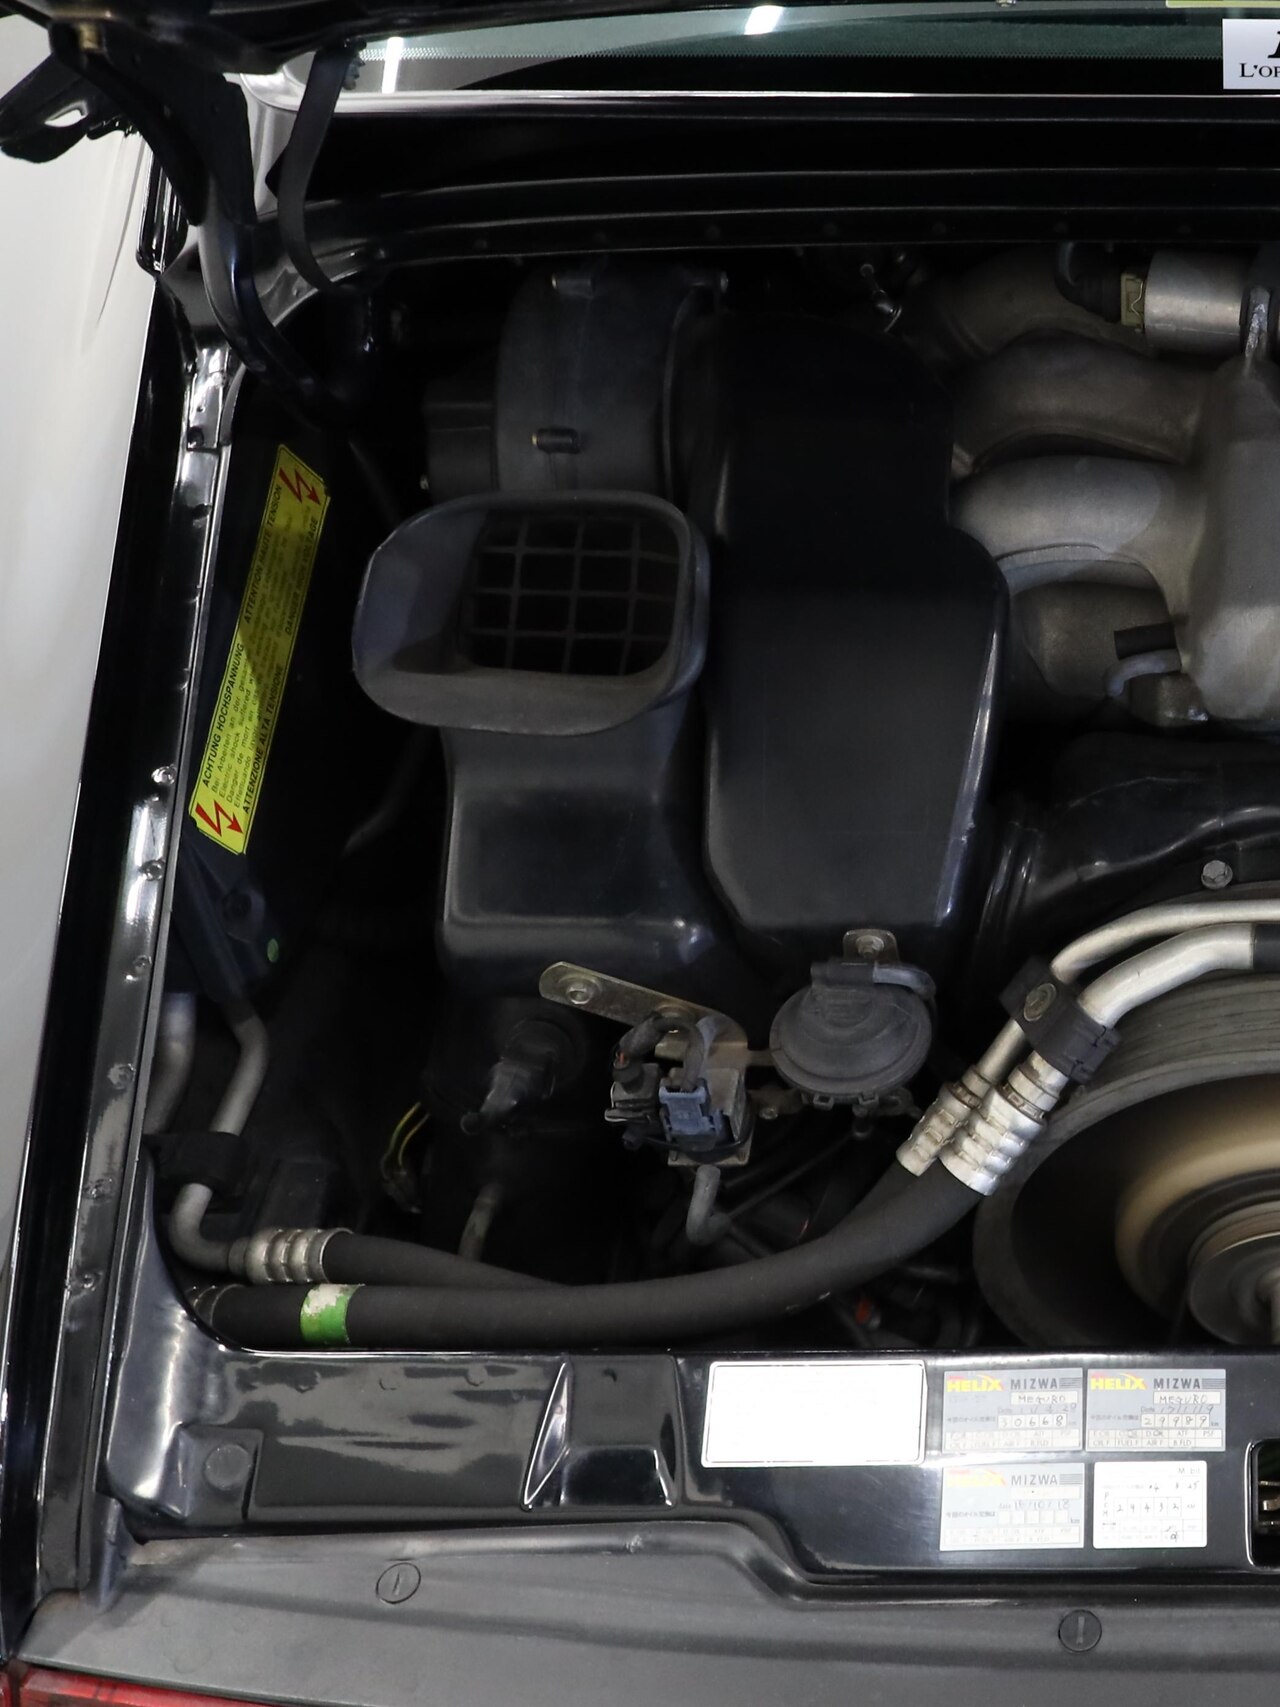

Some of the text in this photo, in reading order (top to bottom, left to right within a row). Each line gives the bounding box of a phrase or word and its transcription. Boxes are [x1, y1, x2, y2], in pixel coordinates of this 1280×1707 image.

[244, 565, 264, 624] ATTENTION
[267, 484, 282, 528] TENSION
[202, 642, 245, 788] ACHTUNG HOCHSPANNUNG
[217, 733, 230, 772] Arbeiten
[242, 664, 284, 815] ATTENZIONE ALTA TENSIONE
[219, 763, 232, 798] Electric
[230, 733, 240, 758] shock
[226, 769, 239, 803] Danger
[946, 1377, 1058, 1392] HELIX MIZWA
[1090, 1377, 1201, 1390] HELIX MIZWA
[1011, 1474, 1058, 1486] MIZWA
